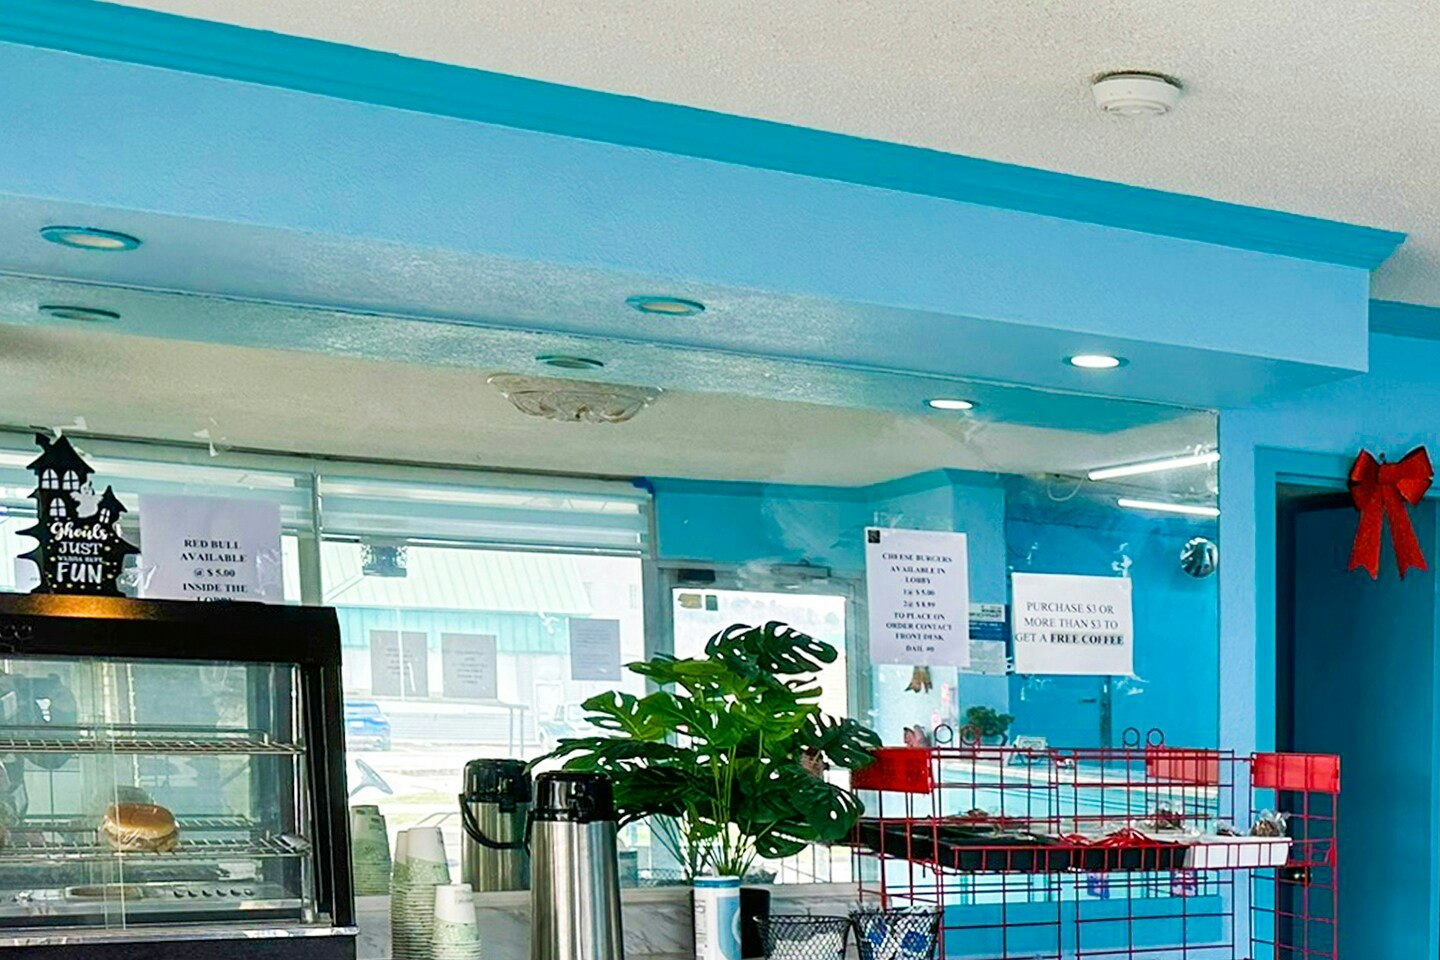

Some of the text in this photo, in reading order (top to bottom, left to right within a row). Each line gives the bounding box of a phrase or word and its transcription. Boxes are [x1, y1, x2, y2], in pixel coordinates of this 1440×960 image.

[58, 541, 103, 555] JUST
[184, 539, 241, 549] RED BULL
[181, 553, 247, 562] AVAILABLE
[882, 552, 952, 563] CHEESE BURGERS
[56, 562, 103, 584] FUN
[890, 565, 934, 574] AVAILABLE
[904, 577, 931, 585] LOBBY
[183, 583, 248, 592] INSIDE THE
[1026, 602, 1115, 614] PURCHASE $3 OR
[1024, 617, 1119, 629] MORE THAN $3 TO
[1014, 633, 1124, 646] GET A FREE COFFEE
